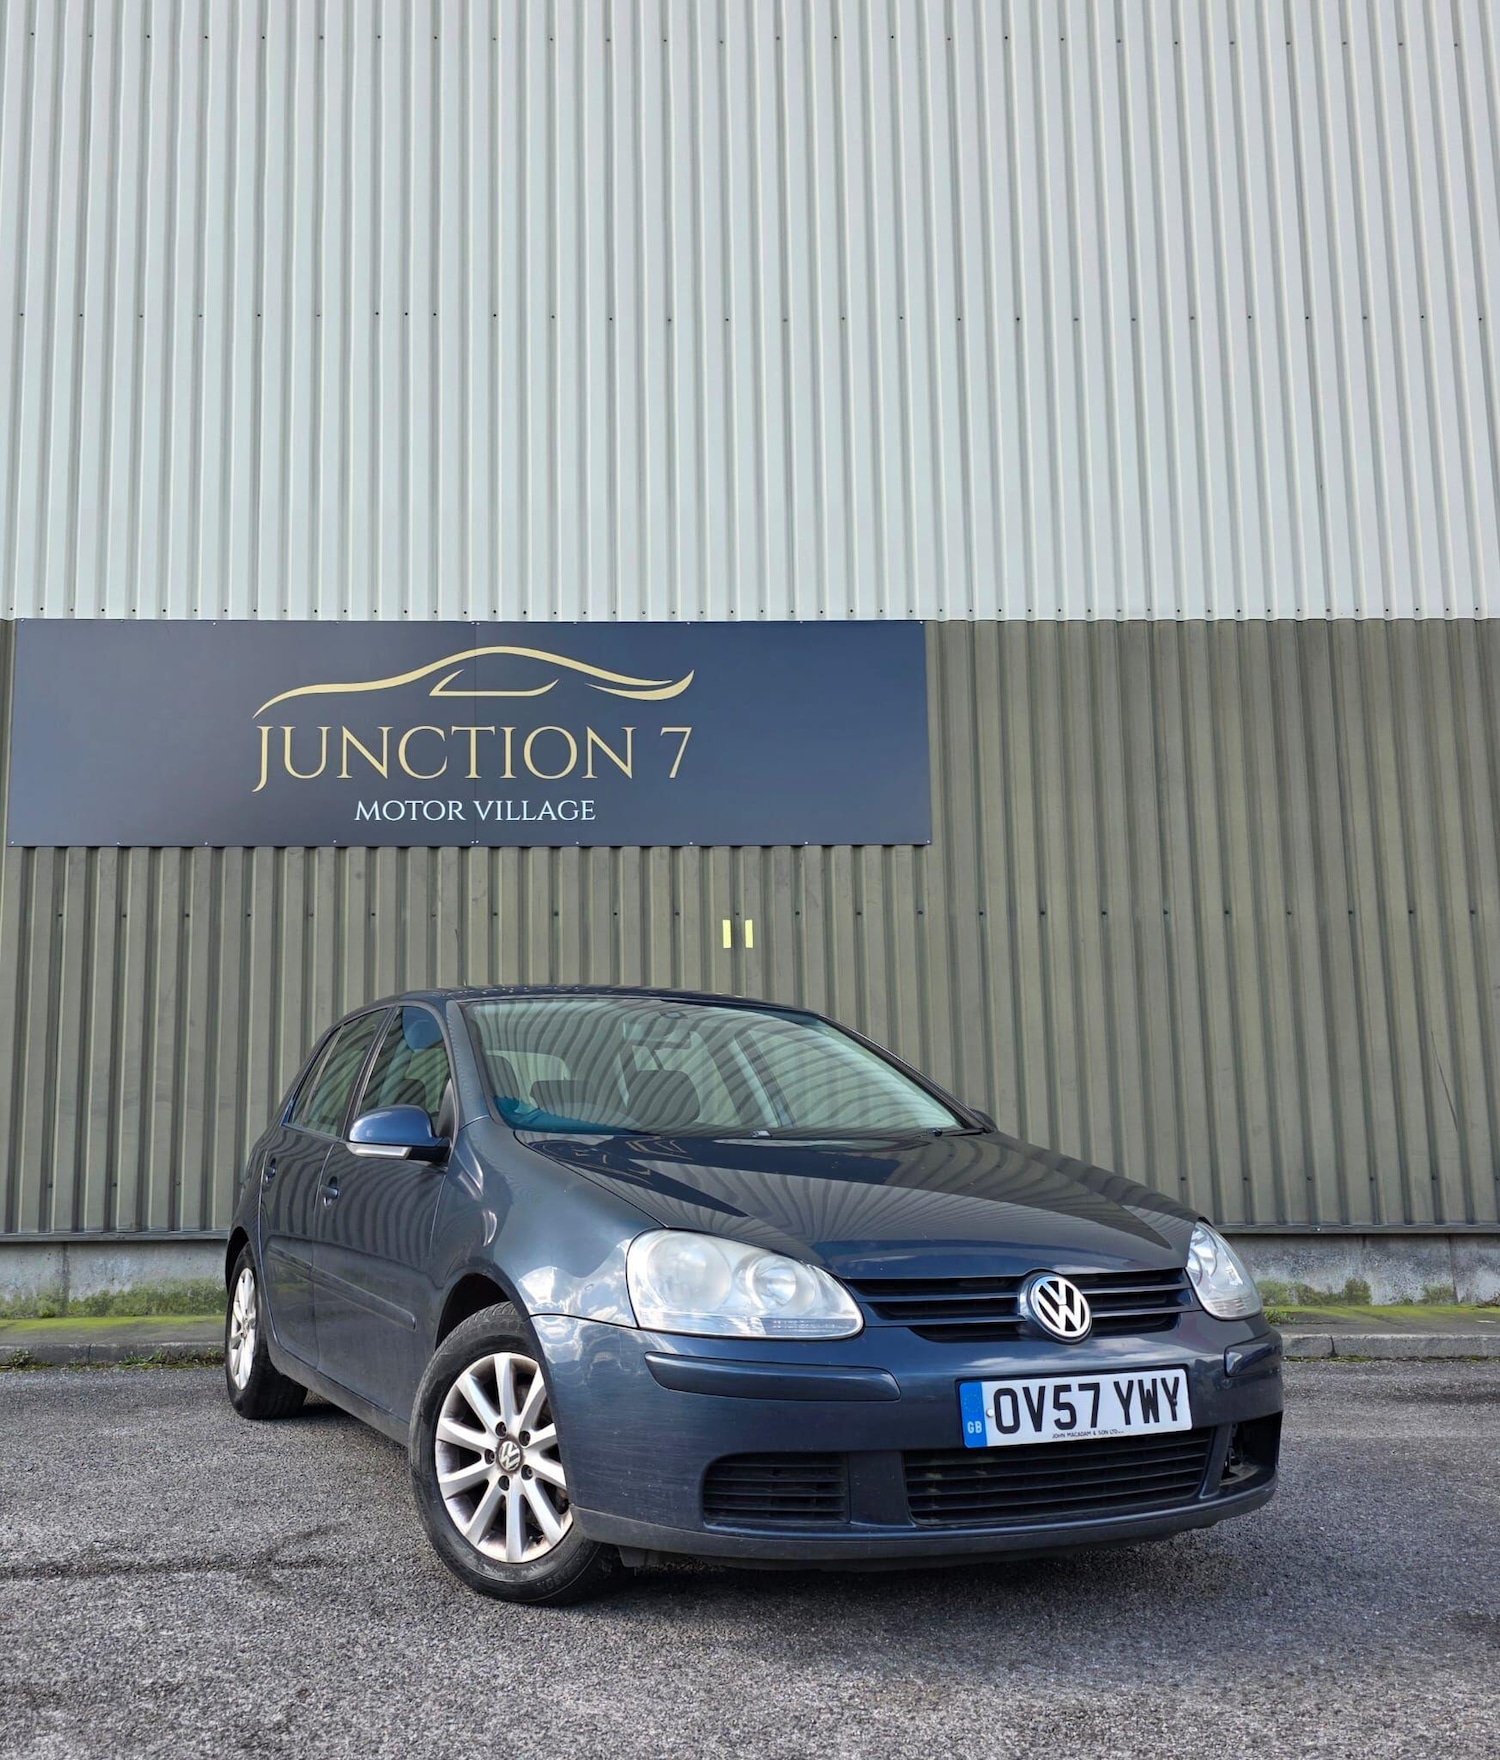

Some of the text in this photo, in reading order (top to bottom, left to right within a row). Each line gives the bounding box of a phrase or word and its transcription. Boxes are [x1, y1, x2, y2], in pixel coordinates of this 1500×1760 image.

[252, 725, 692, 793] JUNCTION 7
[354, 800, 596, 822] MOTOR VILLAGE
[993, 1376, 1180, 1435] OV57 YWY
[967, 1421, 983, 1434] GB
